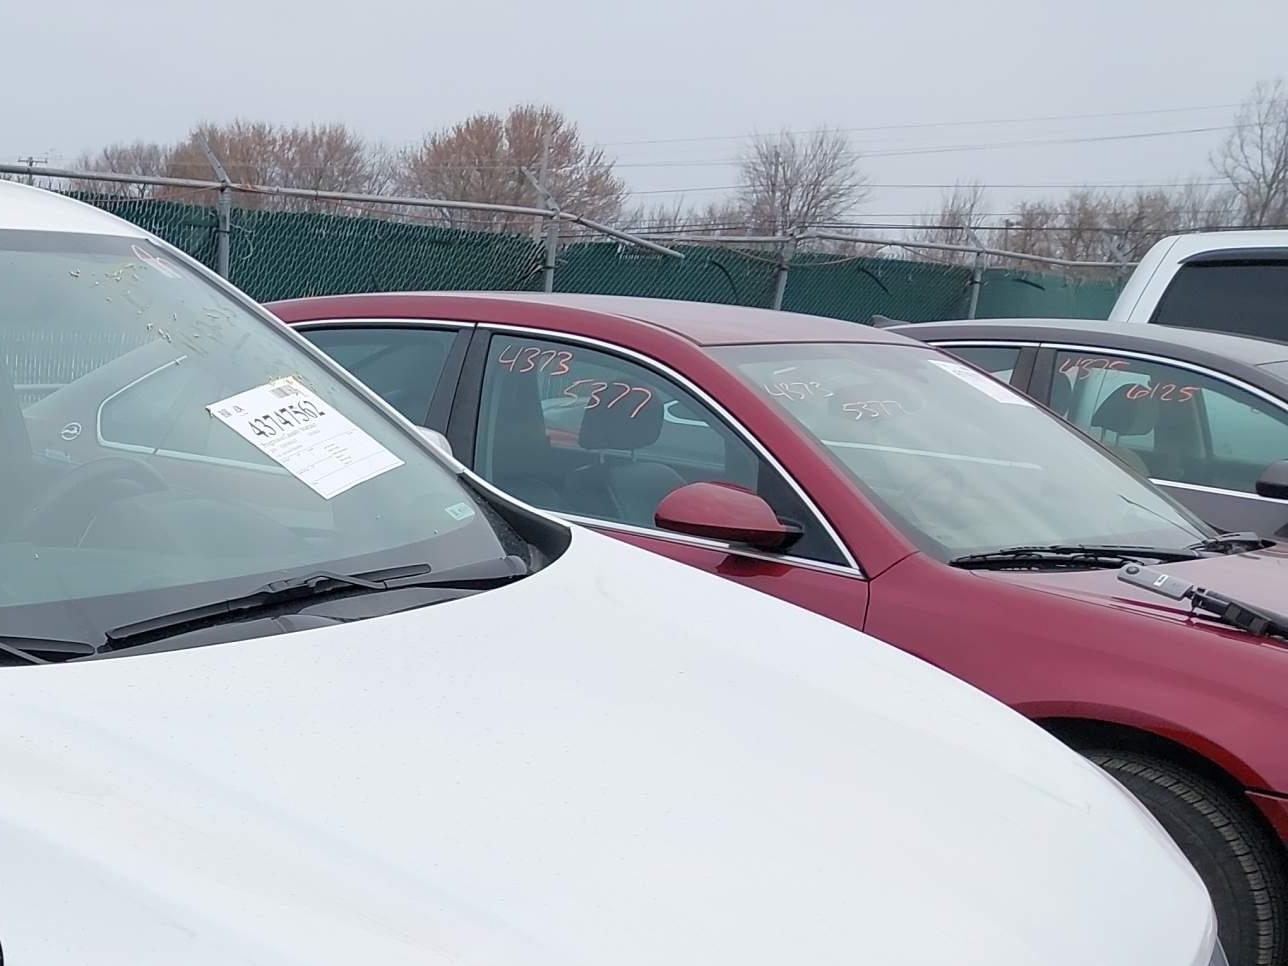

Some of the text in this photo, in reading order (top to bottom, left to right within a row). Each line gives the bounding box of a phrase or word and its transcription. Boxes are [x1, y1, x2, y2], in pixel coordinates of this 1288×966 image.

[497, 344, 573, 376] 4373
[560, 378, 653, 419] 5377
[1126, 382, 1201, 403] 6125
[248, 400, 326, 438] 43747562
